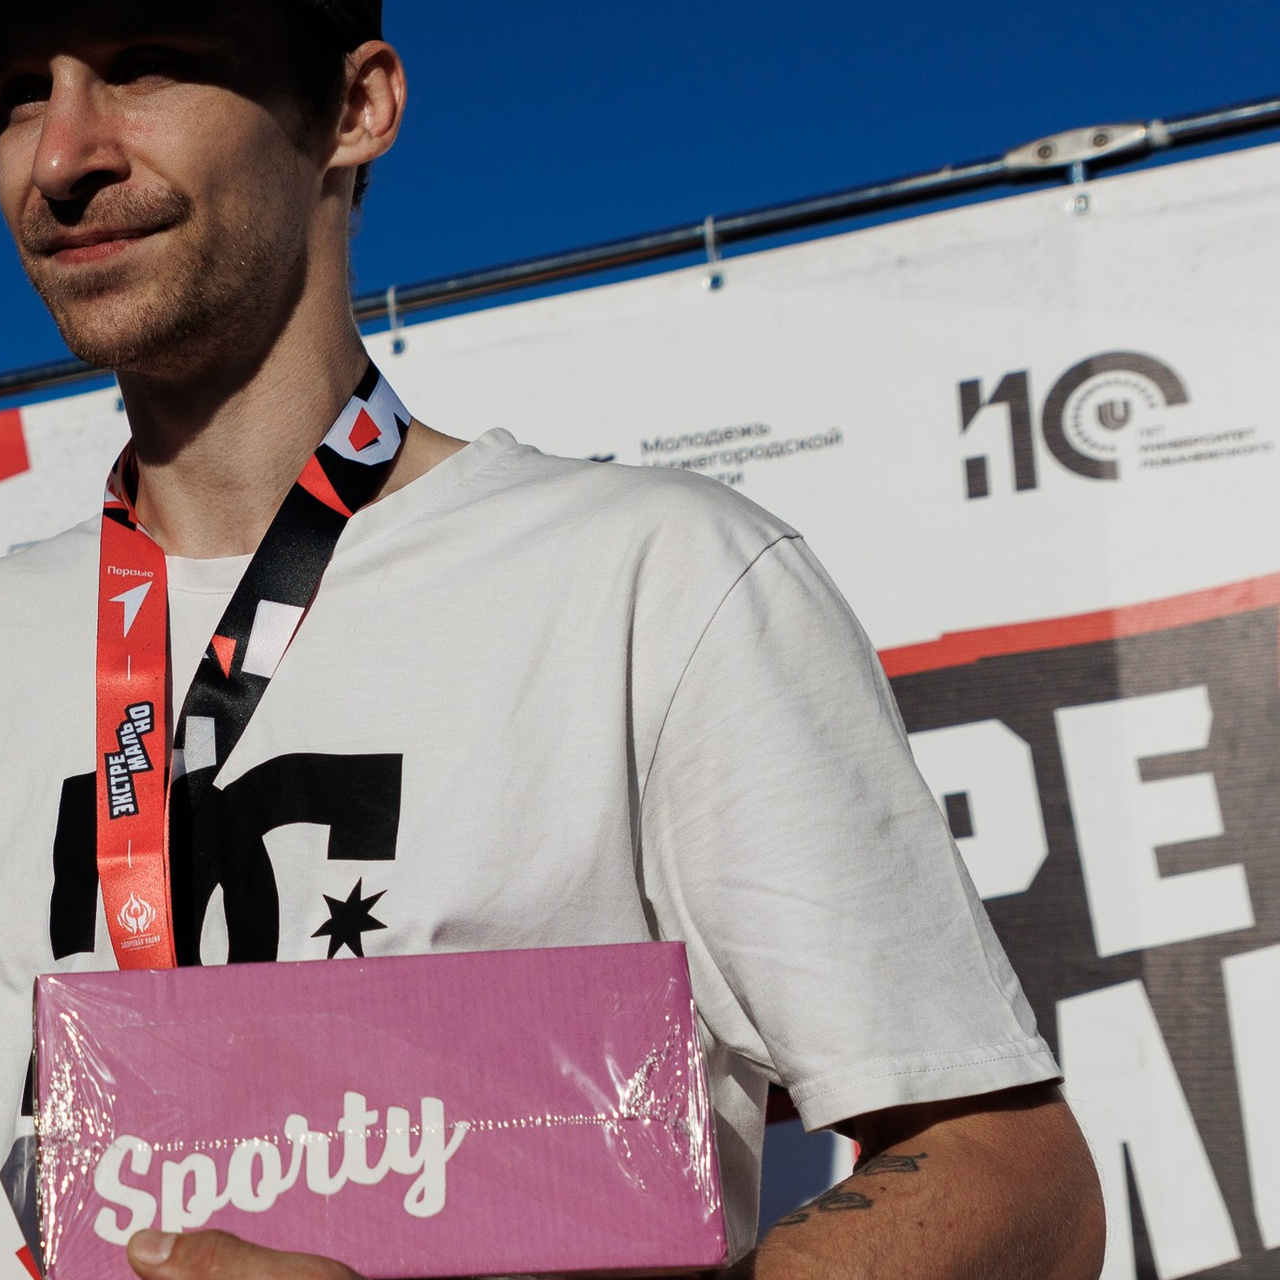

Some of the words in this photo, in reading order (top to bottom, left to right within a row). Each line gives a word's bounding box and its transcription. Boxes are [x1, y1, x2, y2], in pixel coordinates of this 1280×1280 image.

[107, 565, 154, 578] Первые
[128, 704, 151, 734] НО
[120, 722, 149, 771] МАЛЬ
[108, 753, 136, 816] ЭКСТРЕ
[94, 1092, 468, 1247] Sporty
